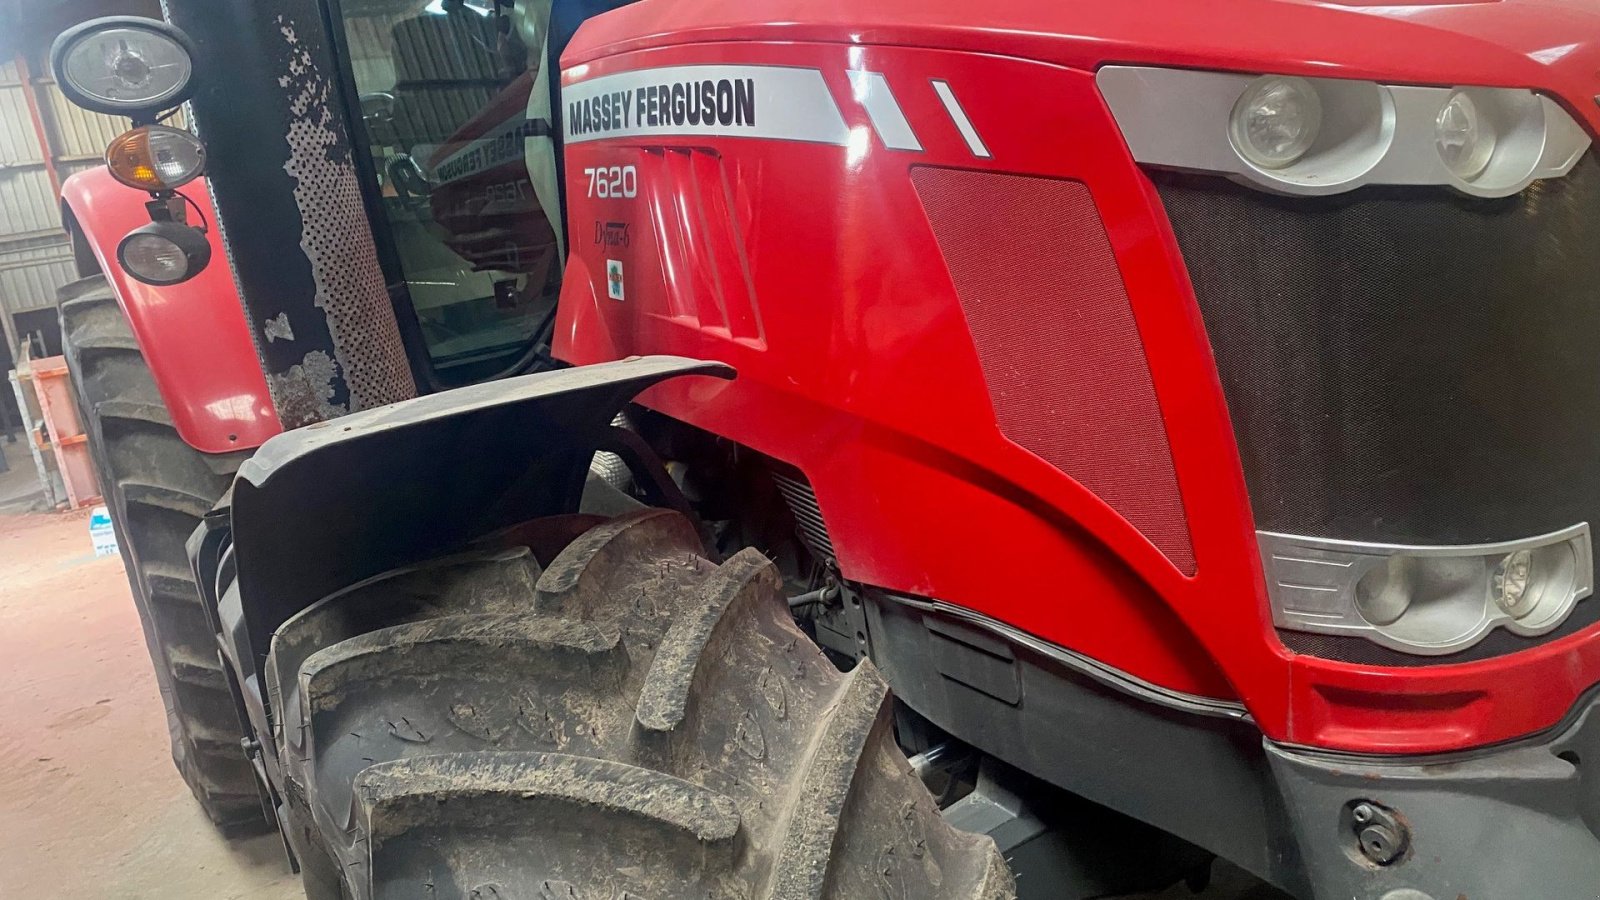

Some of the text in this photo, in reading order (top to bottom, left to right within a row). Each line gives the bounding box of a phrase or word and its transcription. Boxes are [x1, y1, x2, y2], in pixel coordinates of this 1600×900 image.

[570, 78, 756, 136] MASSEY FERGUSON
[584, 165, 637, 198] 7620
